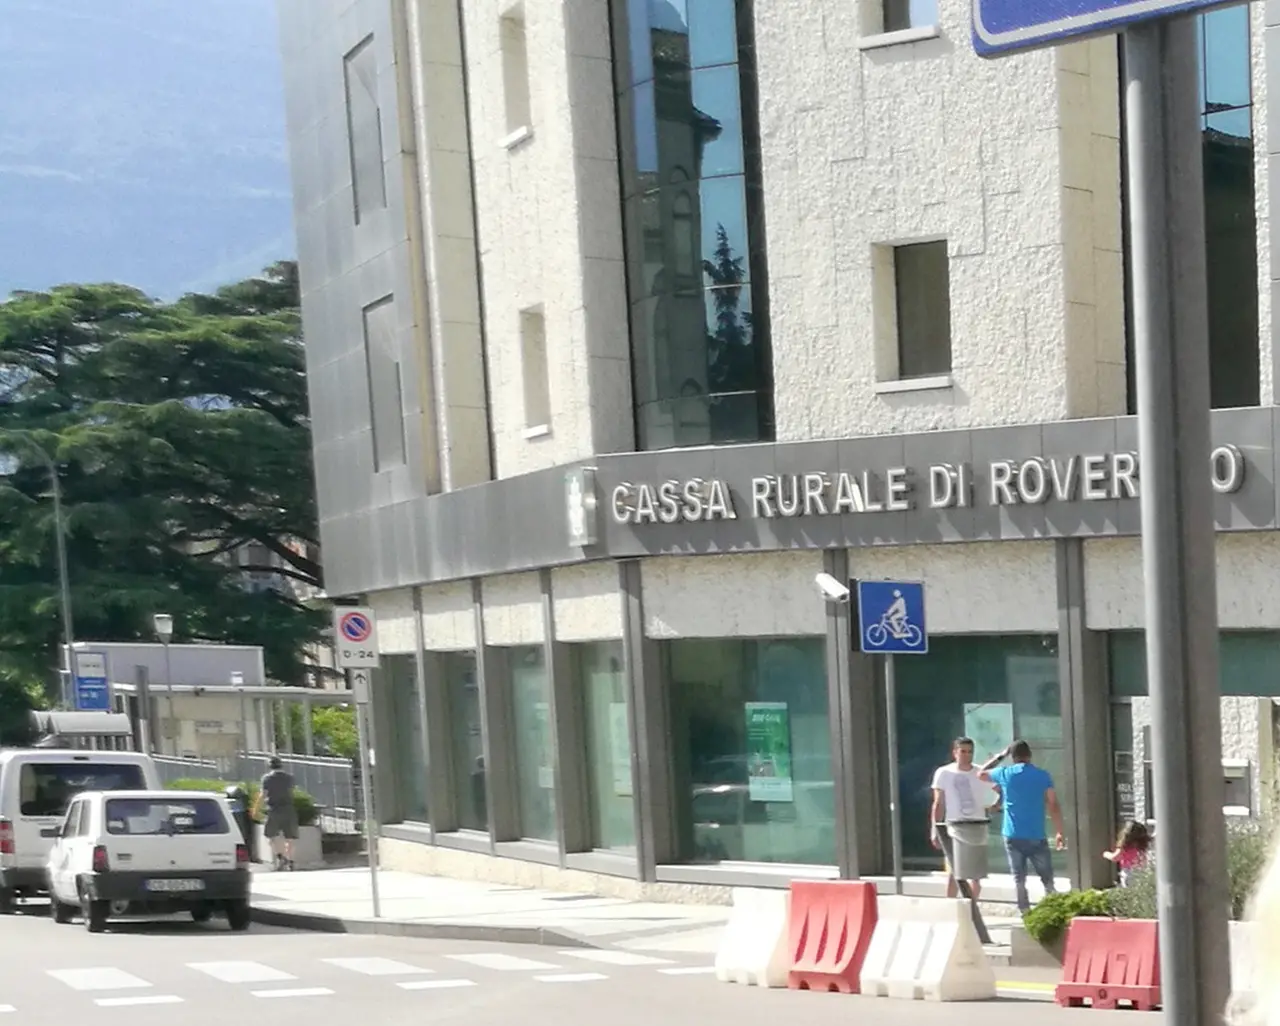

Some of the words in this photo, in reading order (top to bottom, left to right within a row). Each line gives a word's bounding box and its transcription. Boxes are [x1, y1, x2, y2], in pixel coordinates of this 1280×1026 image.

[611, 480, 736, 524] CASSA
[751, 466, 910, 518] RURALE
[929, 462, 967, 508] DI
[988, 443, 1246, 506] ROVERO
